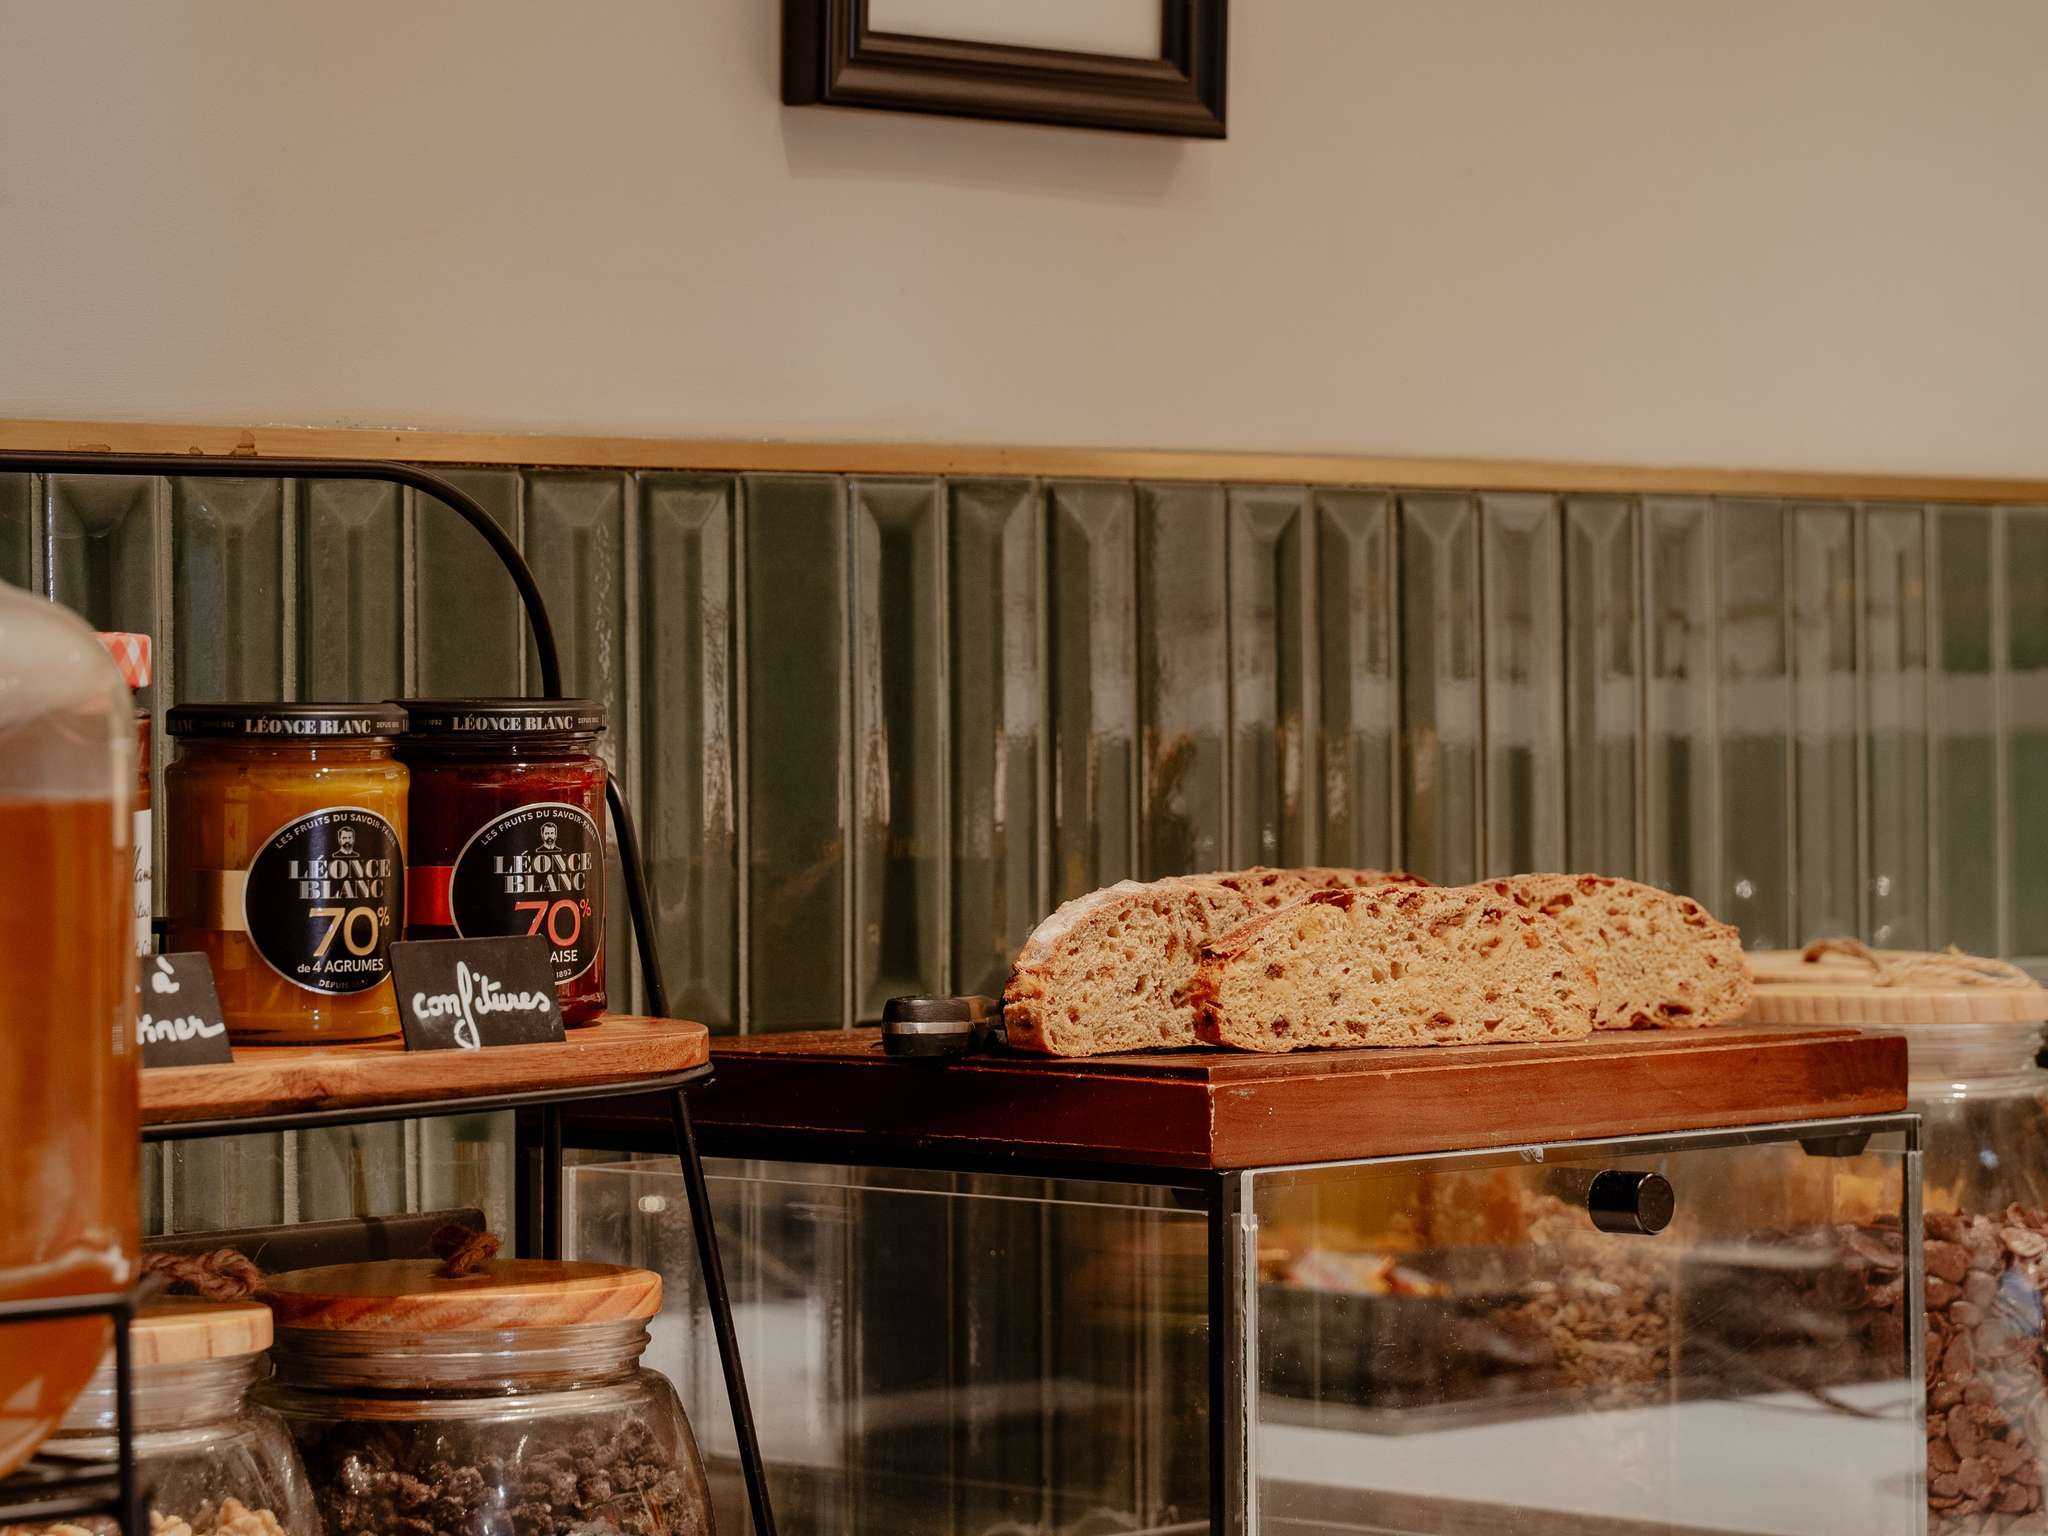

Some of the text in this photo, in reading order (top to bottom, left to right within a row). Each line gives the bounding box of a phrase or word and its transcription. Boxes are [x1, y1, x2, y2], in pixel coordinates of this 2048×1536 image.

[245, 715, 316, 735] LÉONCE
[319, 719, 371, 735] BLANC
[452, 714, 521, 731] LÉONCE
[524, 716, 573, 731] BLANC
[275, 832, 294, 849] LES
[294, 815, 331, 836] FRUITS
[333, 813, 348, 823] DU
[480, 828, 498, 846] LES
[498, 812, 533, 832] FRUITS
[535, 810, 550, 819] DU
[288, 855, 391, 879] LÉONCE
[493, 850, 592, 874] LÉONCE
[299, 880, 384, 899] BLANC
[504, 872, 586, 894] BLANC
[309, 906, 390, 957] 70%
[297, 959, 384, 973] de 4 AGRUMES
[550, 950, 578, 963] AISE
[152, 956, 180, 994] à
[556, 968, 572, 979] 1892
[413, 961, 550, 1051] confitures
